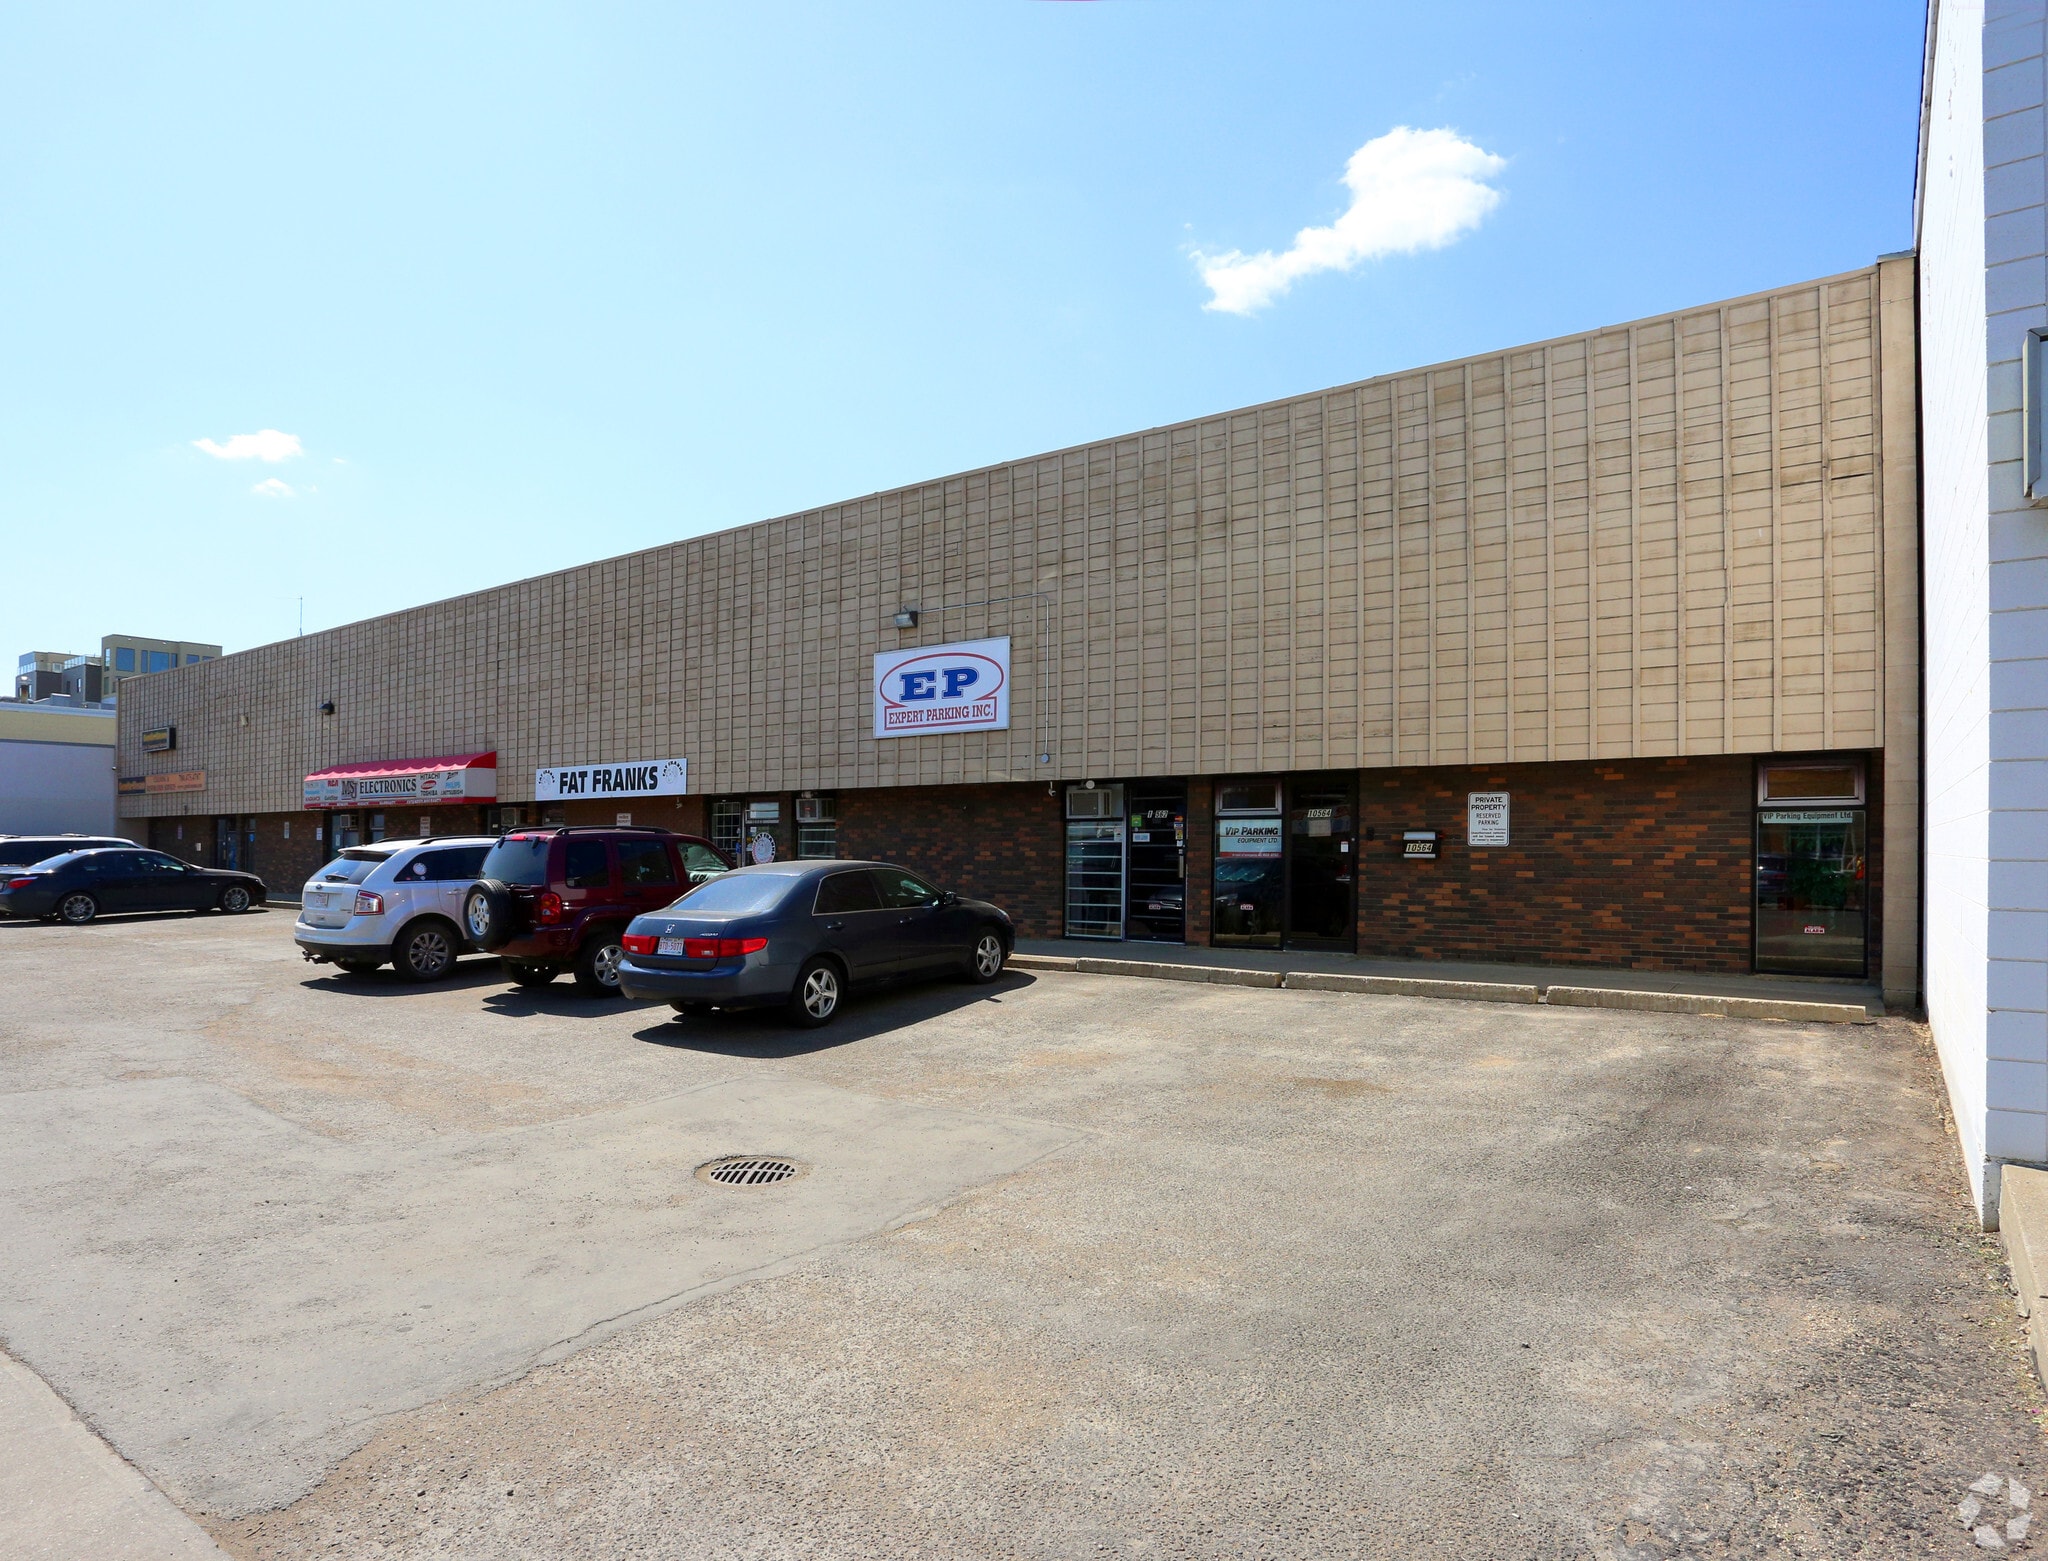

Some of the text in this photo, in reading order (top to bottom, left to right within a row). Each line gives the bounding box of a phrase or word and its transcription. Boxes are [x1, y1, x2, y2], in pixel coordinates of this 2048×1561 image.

[899, 666, 980, 702] EP
[889, 703, 993, 724] EXPERT PARKING INC.
[420, 772, 440, 780] HITACHI
[559, 766, 658, 795] FAT FRANKS
[359, 778, 417, 794] ELECTRONICS
[1308, 809, 1332, 817] 10564
[1776, 812, 1800, 821] Parking
[1803, 811, 1838, 821] Equipment
[1840, 811, 1853, 819] Ltd.
[1240, 826, 1279, 836] PARKING
[1406, 843, 1433, 852] 10564
